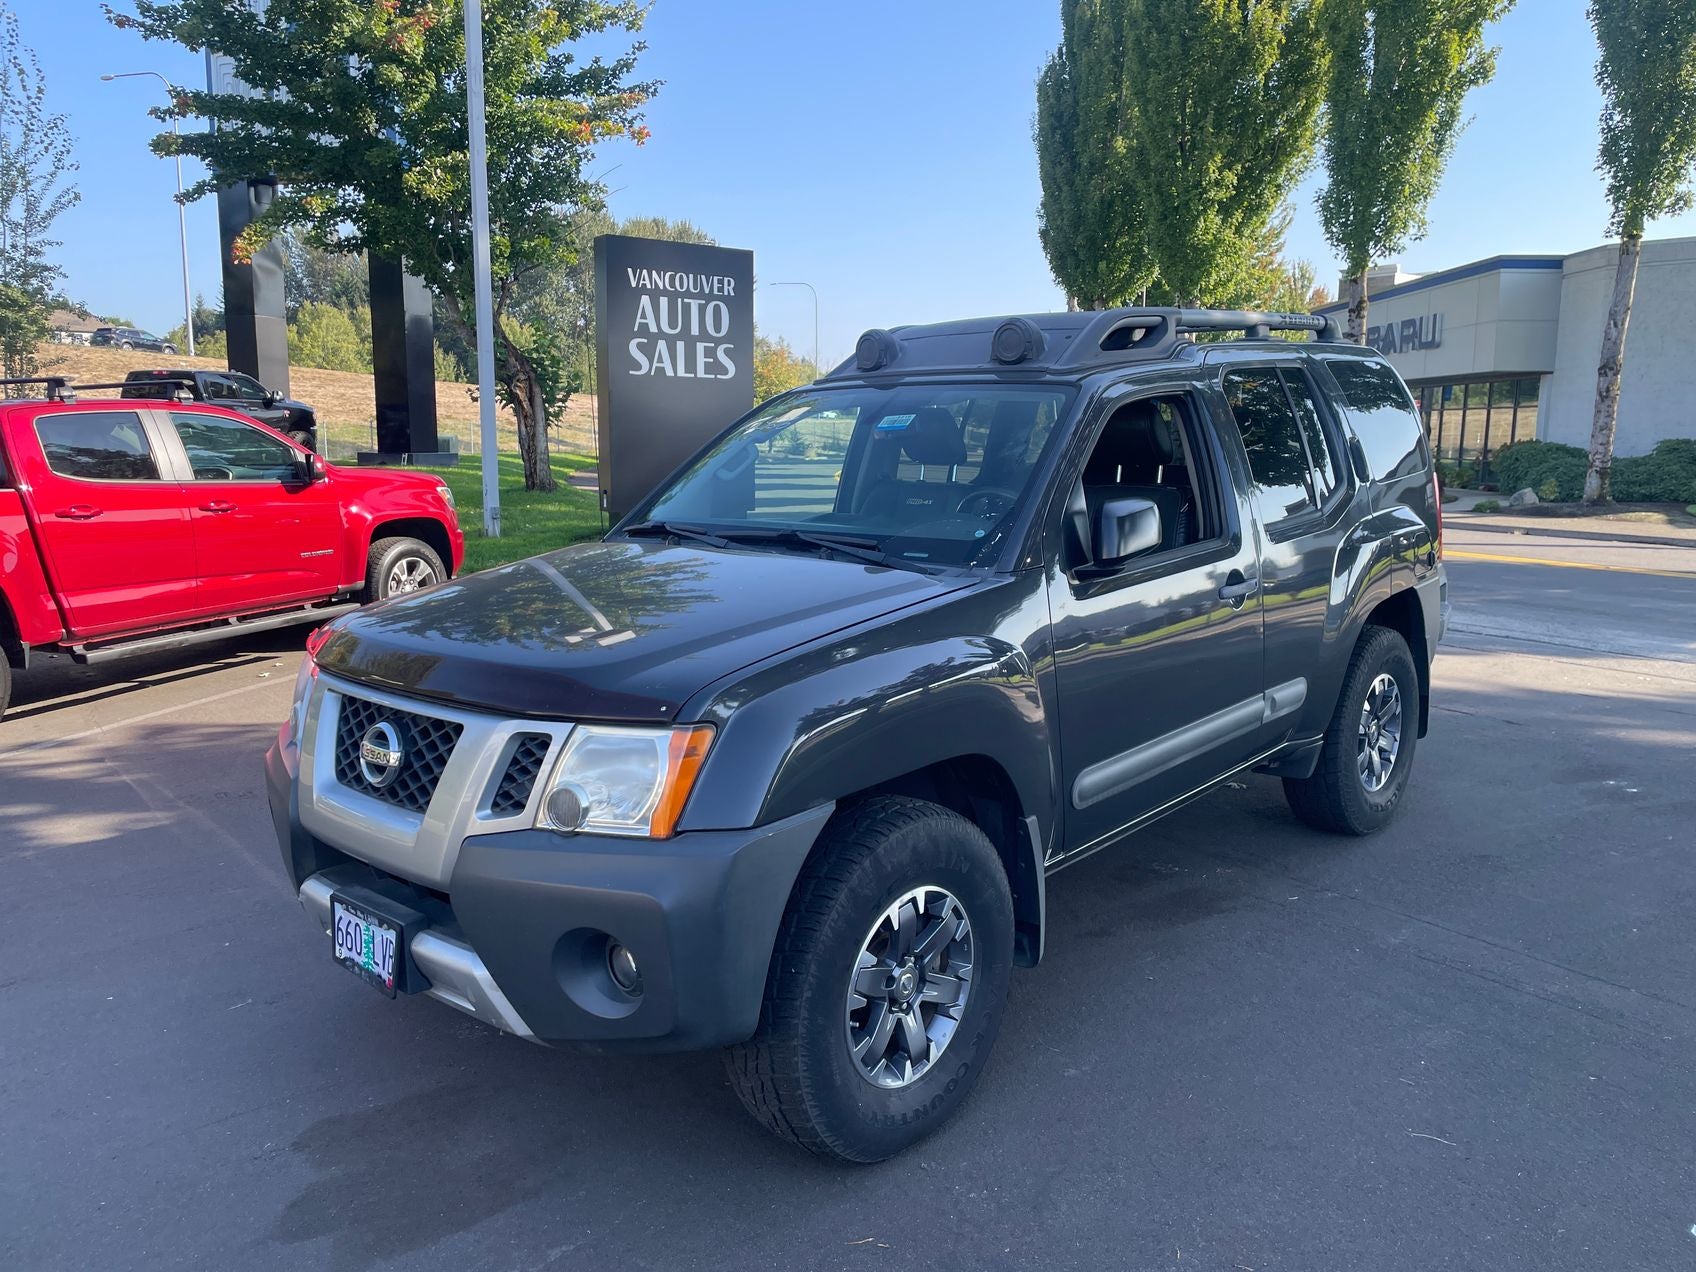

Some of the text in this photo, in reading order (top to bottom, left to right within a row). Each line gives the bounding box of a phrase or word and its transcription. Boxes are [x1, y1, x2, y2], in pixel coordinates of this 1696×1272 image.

[627, 267, 735, 296] VANCOUVER
[633, 294, 730, 337] AUTO
[628, 338, 736, 380] SALES
[336, 915, 363, 957] 660
